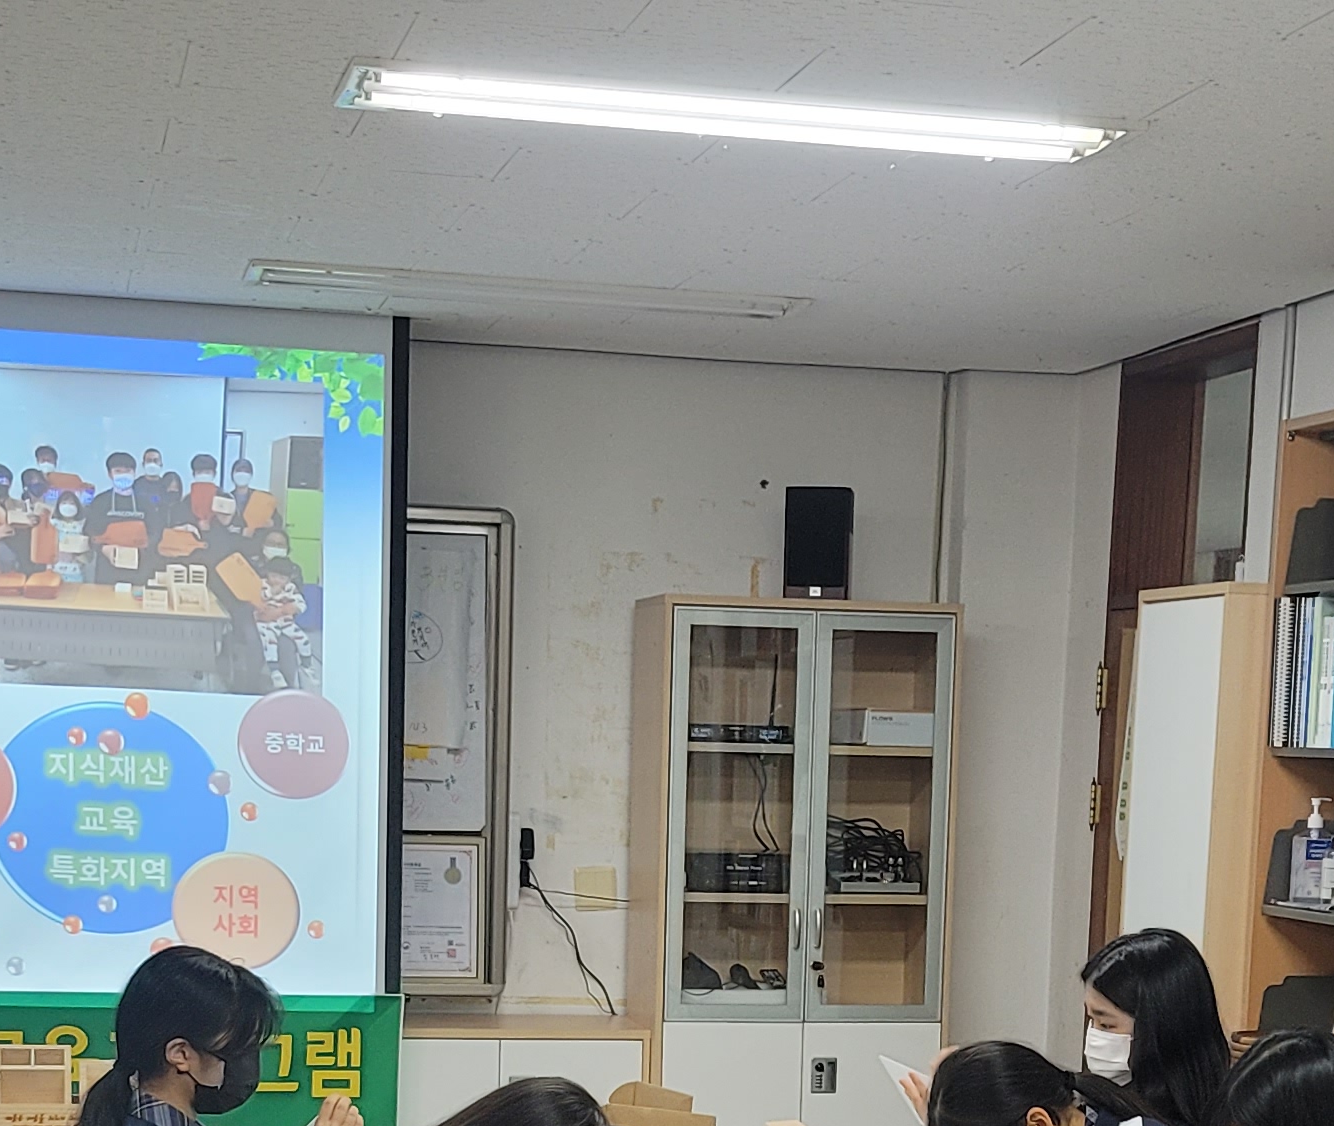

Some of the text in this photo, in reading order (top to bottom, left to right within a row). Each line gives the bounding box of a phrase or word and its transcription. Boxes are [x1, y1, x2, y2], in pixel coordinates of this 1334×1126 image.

[264, 732, 326, 756] 중학교
[48, 752, 169, 786] 지식재산
[78, 806, 139, 835] 교육
[49, 855, 168, 887] 특화지역
[214, 885, 260, 909] 지역
[213, 914, 260, 939] 사회
[259, 1028, 361, 1098] 그램
